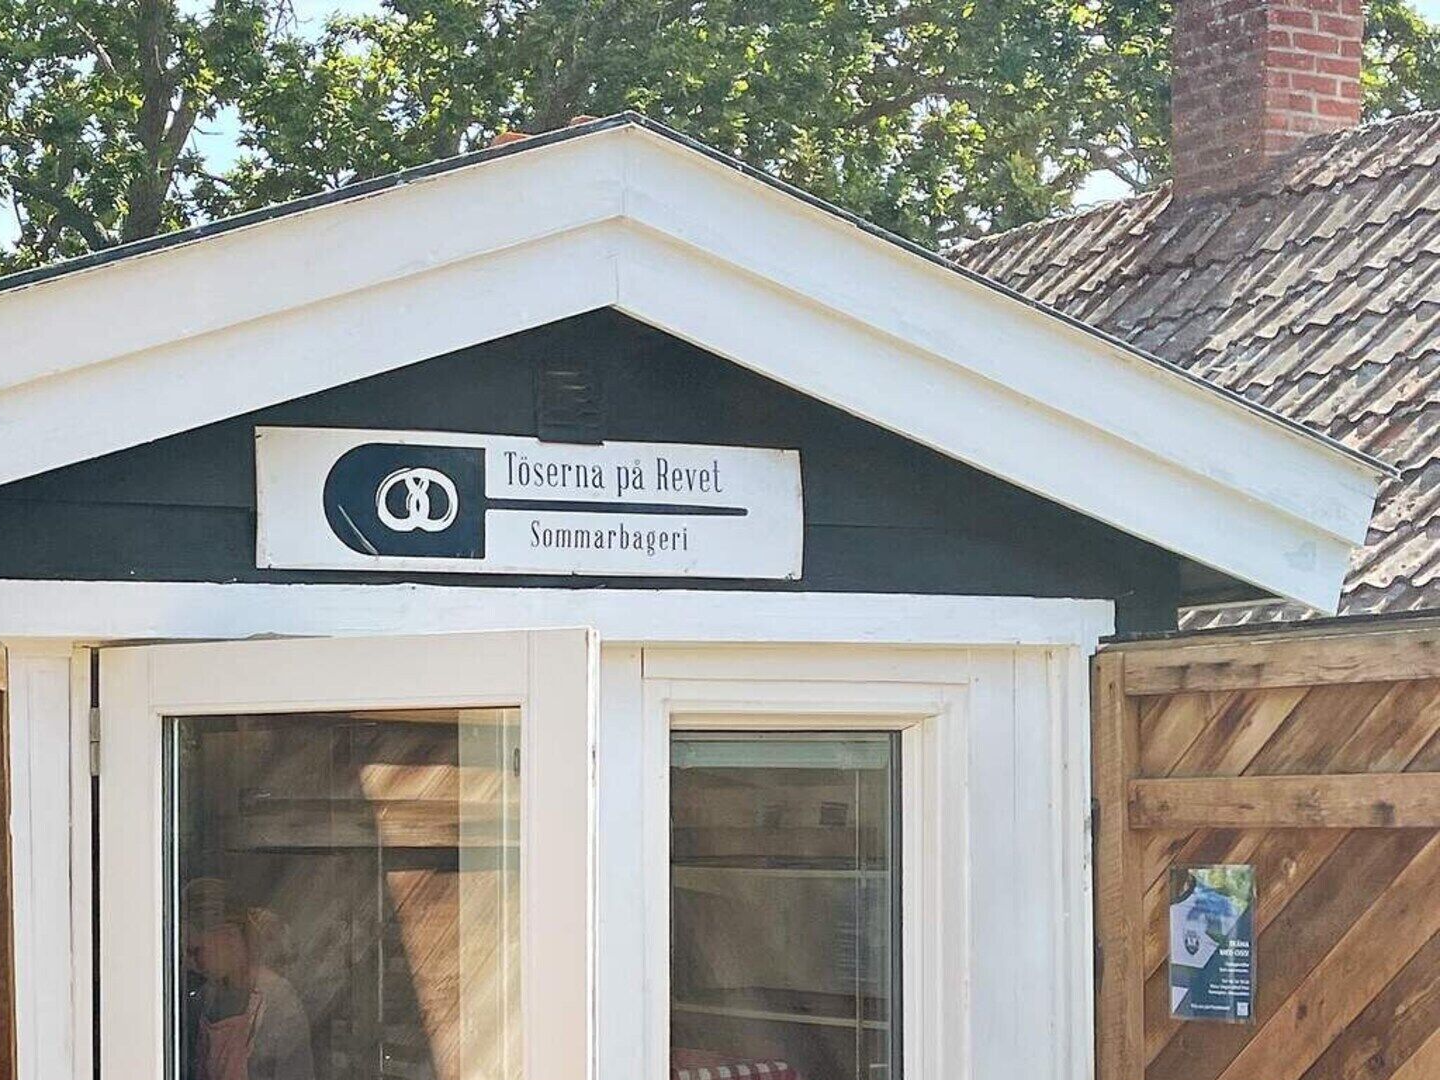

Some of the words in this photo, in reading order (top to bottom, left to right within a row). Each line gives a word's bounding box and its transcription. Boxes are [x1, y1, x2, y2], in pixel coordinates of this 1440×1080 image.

[504, 451, 605, 489] Töserna
[616, 459, 645, 497] på
[656, 457, 723, 493] Revet
[530, 520, 688, 557] Sommarbageri
